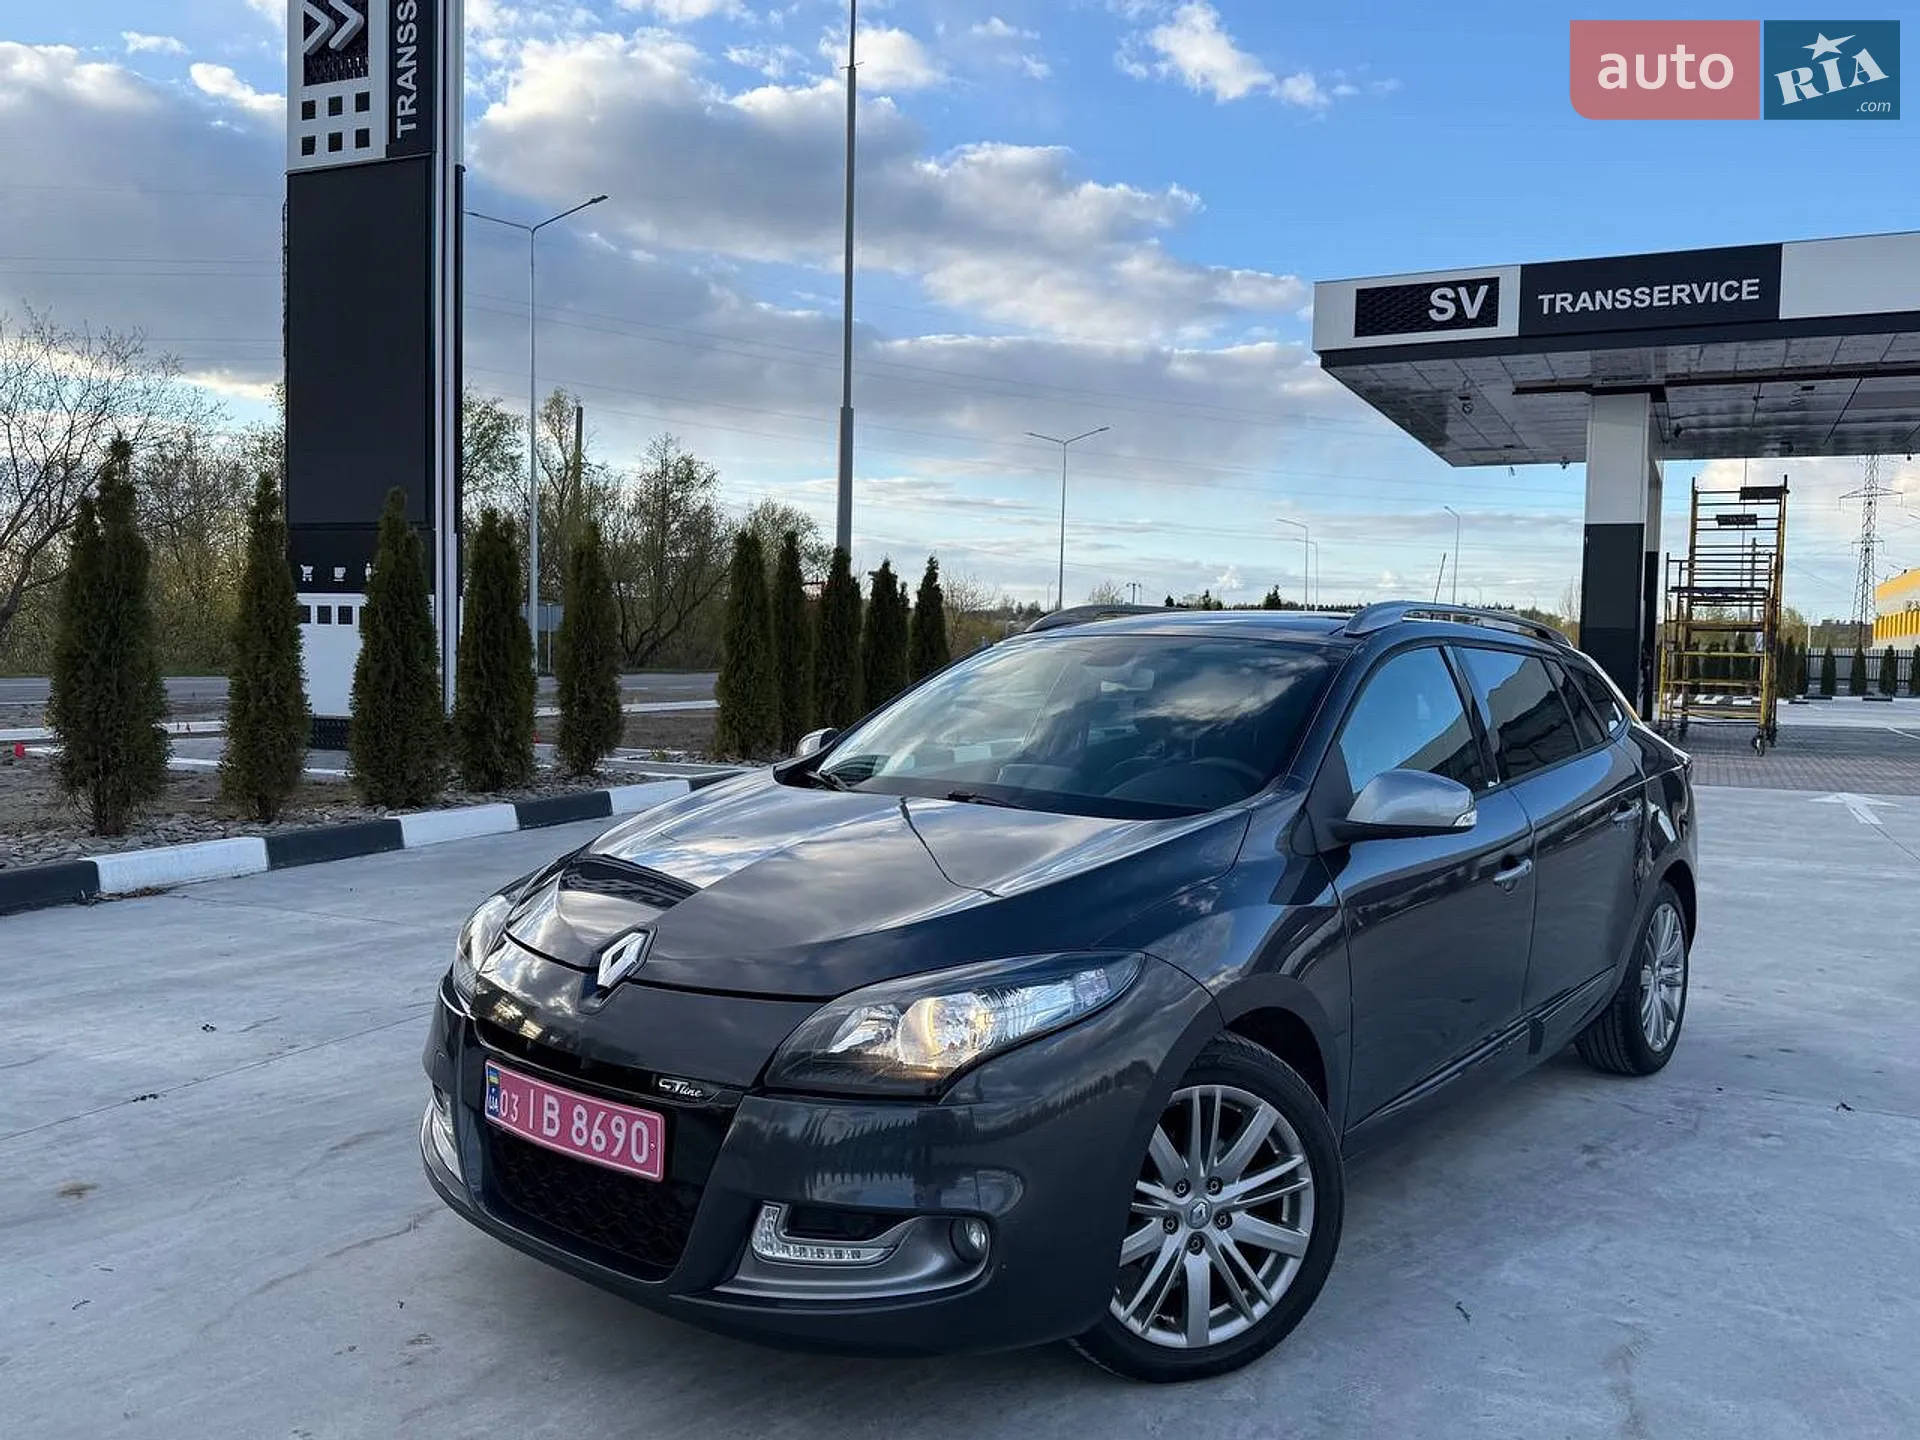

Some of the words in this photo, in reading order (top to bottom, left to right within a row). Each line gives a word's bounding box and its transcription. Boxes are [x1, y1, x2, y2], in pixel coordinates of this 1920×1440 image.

[1428, 285, 1488, 322] SV
[1538, 279, 1760, 315] TRANSSERVICE
[571, 1104, 649, 1164] 8690
